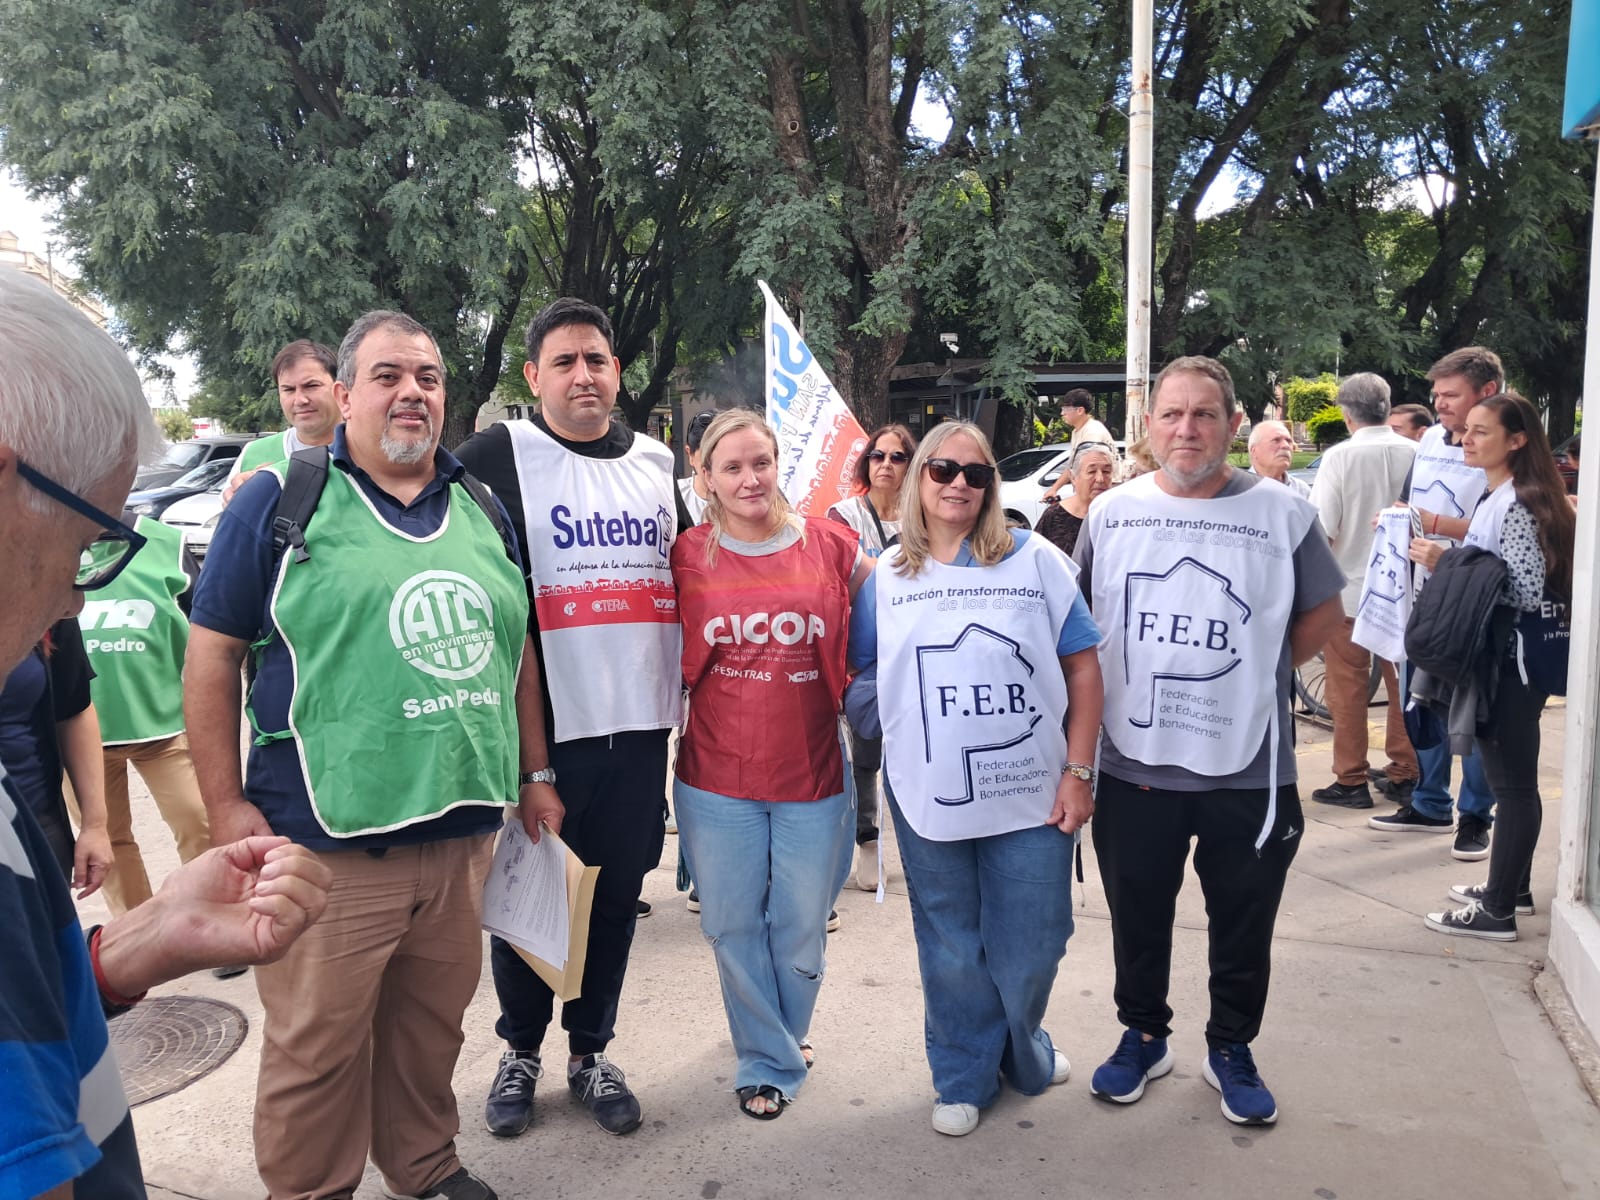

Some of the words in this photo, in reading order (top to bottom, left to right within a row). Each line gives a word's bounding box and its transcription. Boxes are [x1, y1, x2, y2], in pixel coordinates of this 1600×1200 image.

[550, 504, 657, 549] Suteba
[1106, 518, 1119, 529] La
[1122, 515, 1161, 528] acción
[1165, 517, 1269, 540] transformadora
[1152, 528, 1176, 543] de
[1179, 529, 1206, 545] los
[569, 560, 598, 574] defensa
[601, 560, 609, 569] de
[611, 559, 619, 569] la
[892, 596, 903, 606] La
[906, 588, 943, 603] acción
[947, 586, 1045, 600] transformadora
[937, 597, 958, 612] de
[963, 597, 988, 610] los
[703, 611, 825, 647] CICOP
[1138, 611, 1237, 655] F.E.B.
[1555, 630, 1570, 638] Pro
[86, 637, 146, 653] Pedro
[402, 647, 421, 661] en
[424, 629, 495, 654] movimiento
[714, 664, 772, 682] FESINTRAS
[402, 694, 455, 719] San
[455, 687, 500, 708] Pedr
[936, 683, 1036, 717] F.E.B.
[1160, 688, 1219, 708] Federación
[1160, 703, 1173, 713] de
[1175, 704, 1233, 727] Educadores
[1159, 718, 1222, 740] Bonaerenses
[976, 757, 1034, 771] Federación
[979, 774, 992, 786] de
[994, 768, 1052, 785] Educadore
